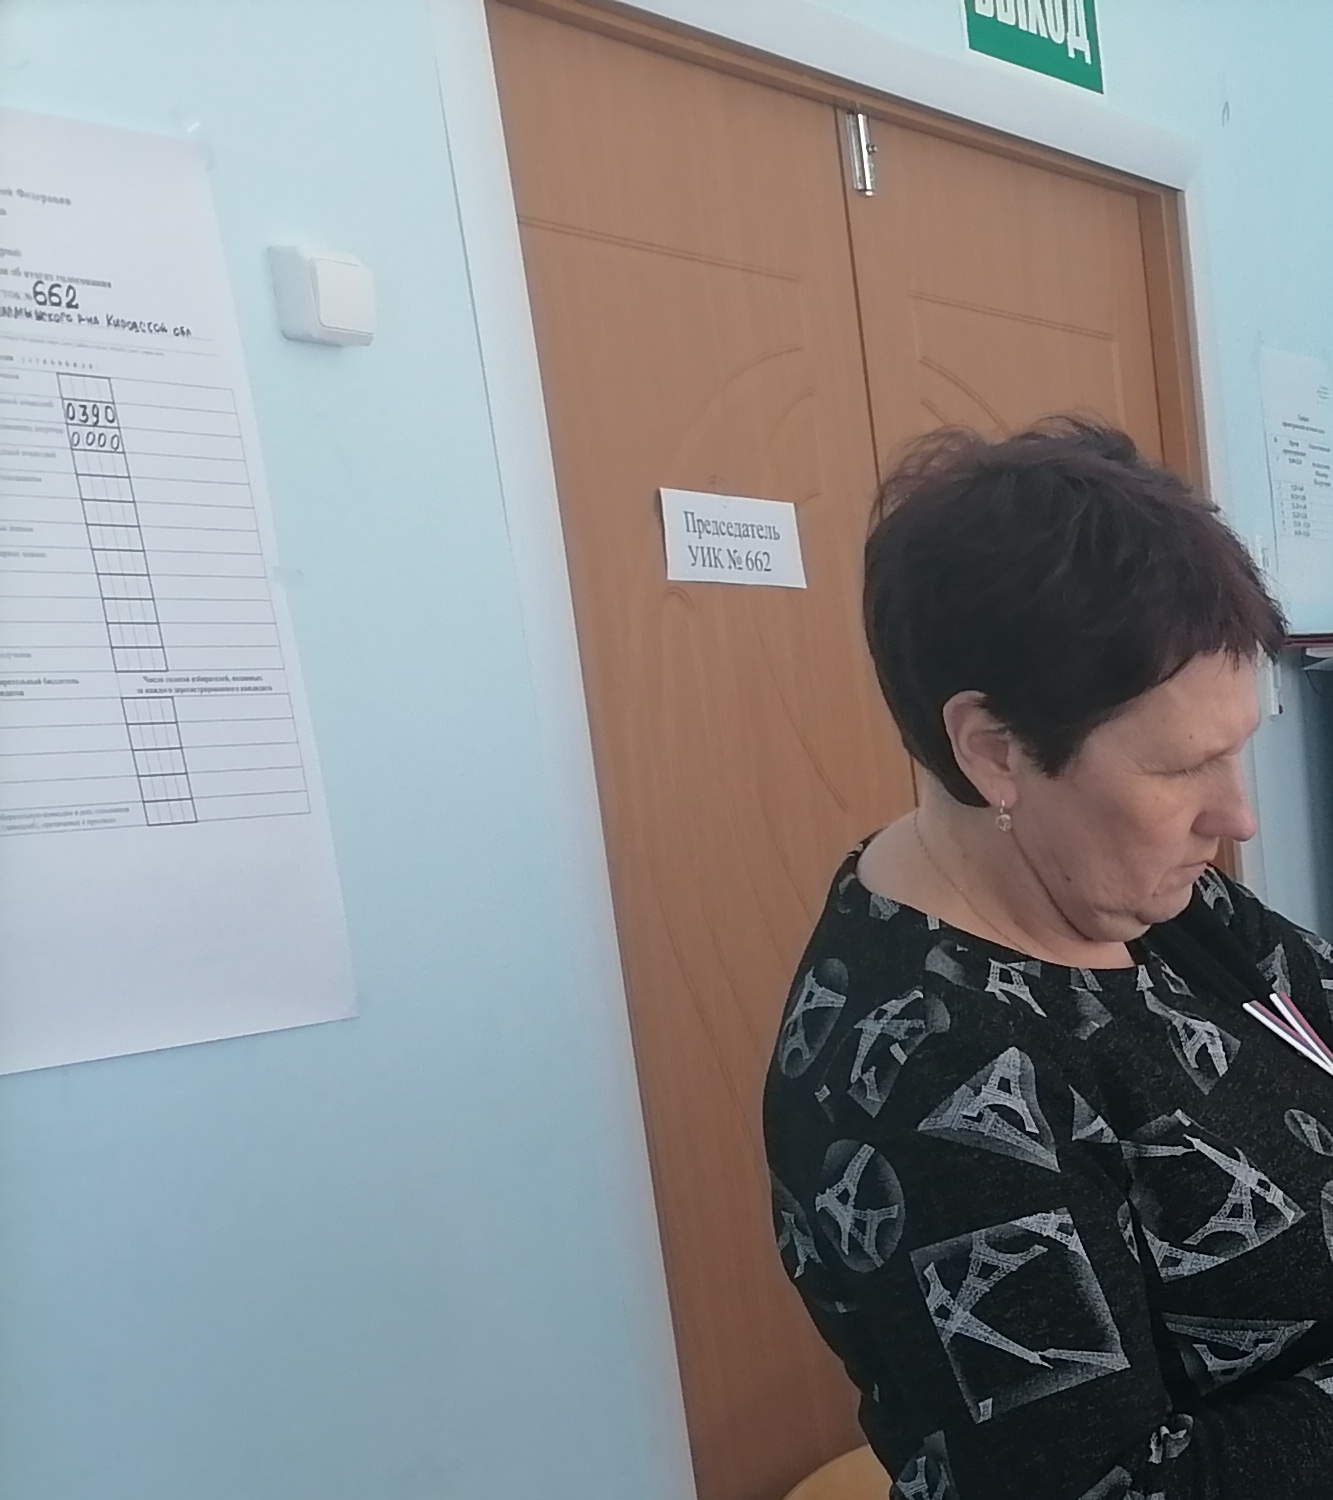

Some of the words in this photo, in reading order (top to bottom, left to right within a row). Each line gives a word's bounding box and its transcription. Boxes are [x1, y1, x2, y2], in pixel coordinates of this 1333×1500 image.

[33, 280, 79, 309] 662
[66, 402, 116, 426] 0390
[71, 431, 120, 451] 0000
[683, 510, 781, 540] Председатель
[688, 545, 725, 569] УИК
[726, 548, 743, 570] №
[745, 551, 772, 572] 662
